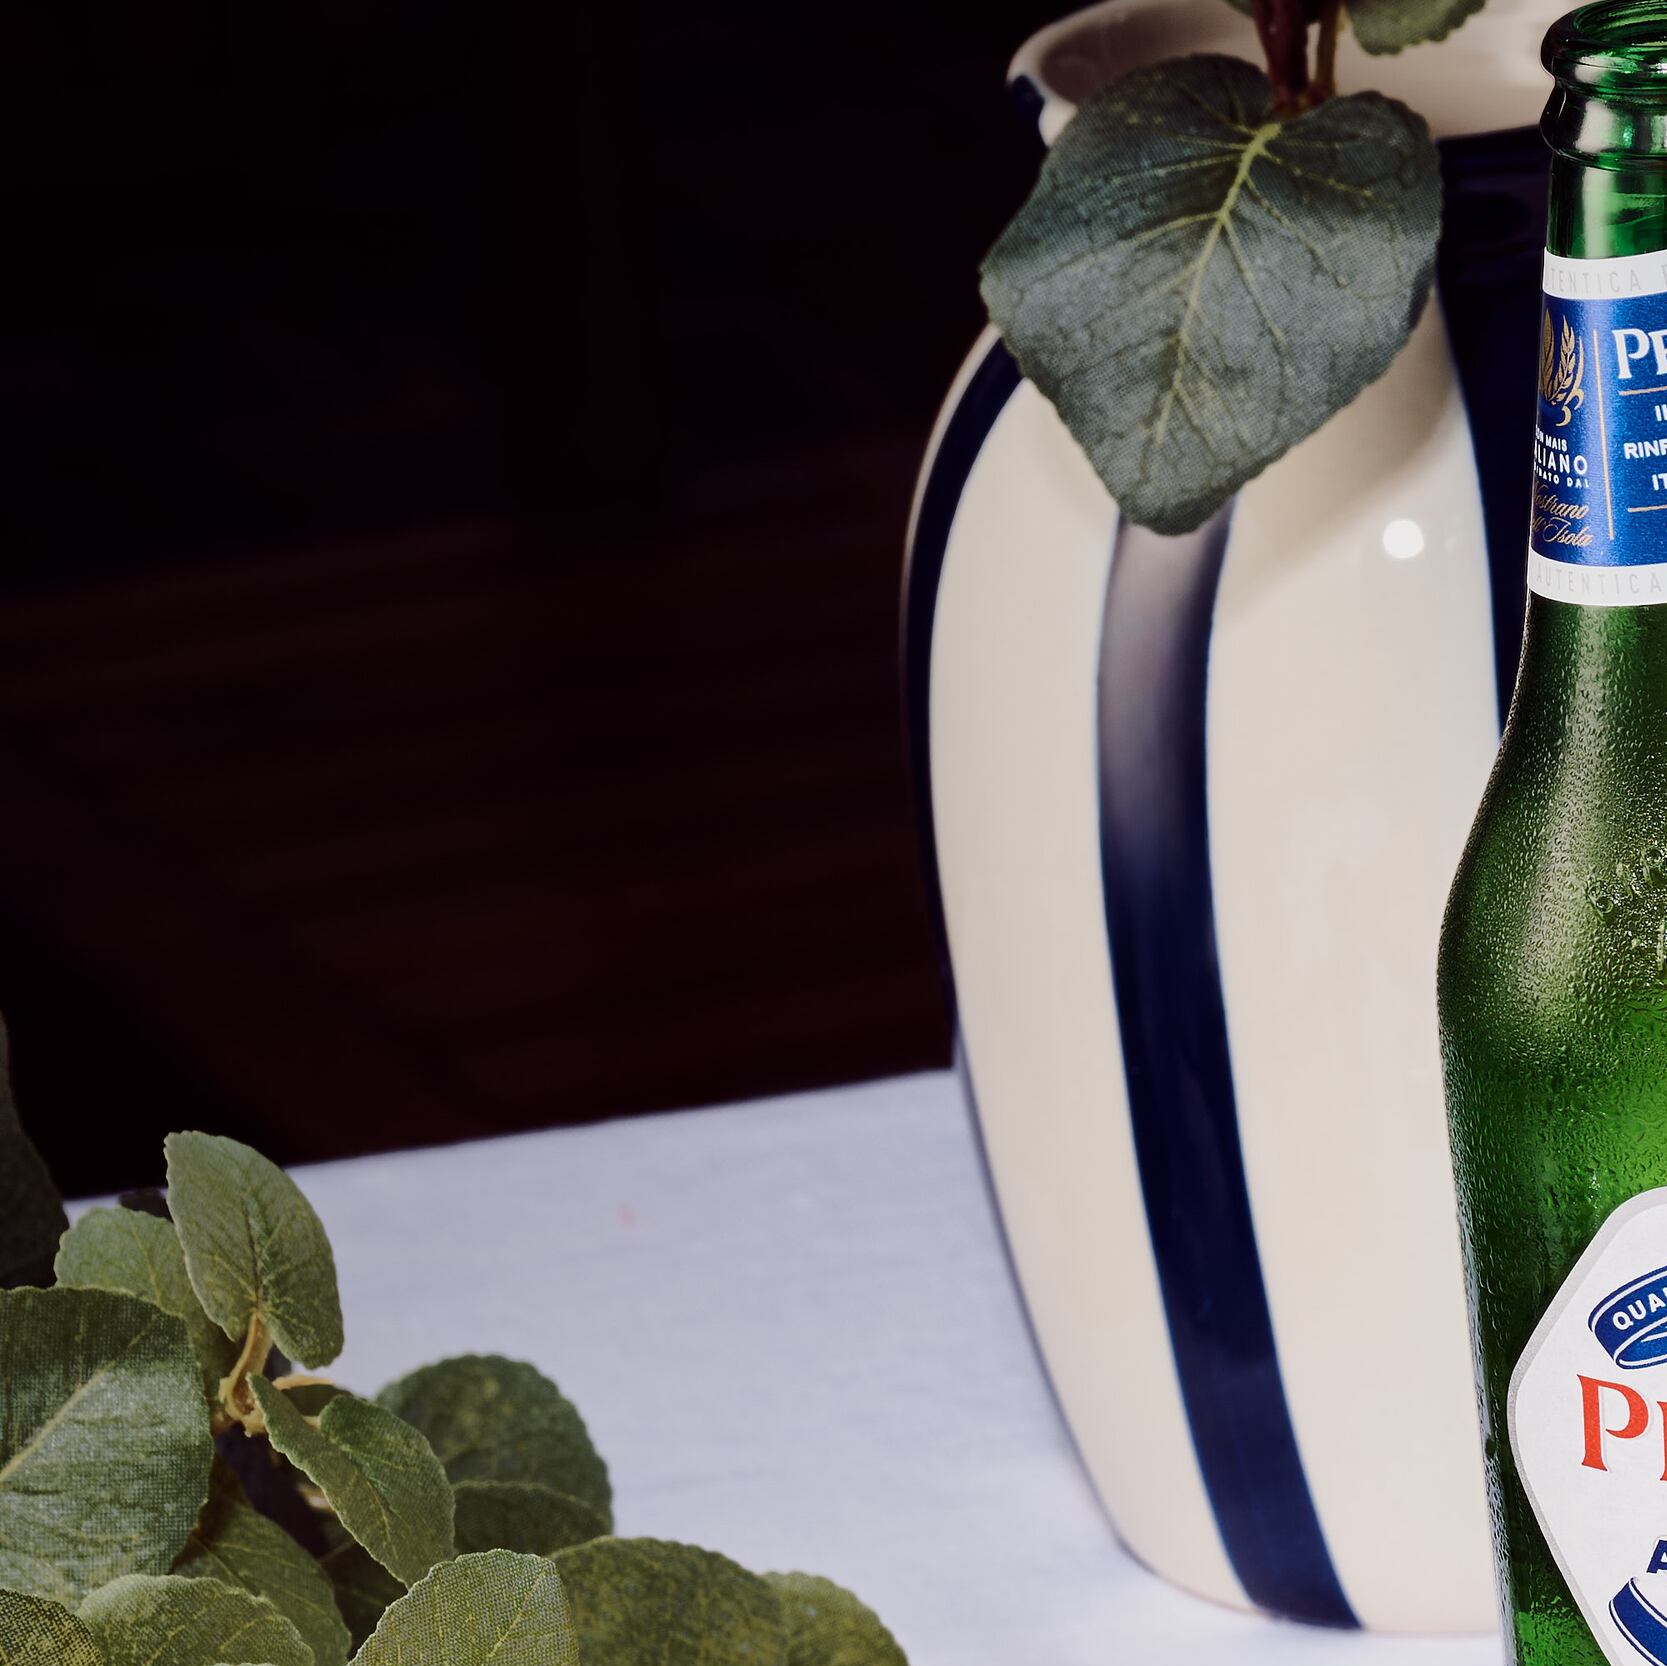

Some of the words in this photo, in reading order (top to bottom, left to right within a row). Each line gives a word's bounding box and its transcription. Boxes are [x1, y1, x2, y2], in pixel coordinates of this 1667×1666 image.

[1545, 434, 1568, 452] MAIS
[1566, 477, 1590, 488] DAL
[1536, 562, 1662, 595] AUTENTICA
